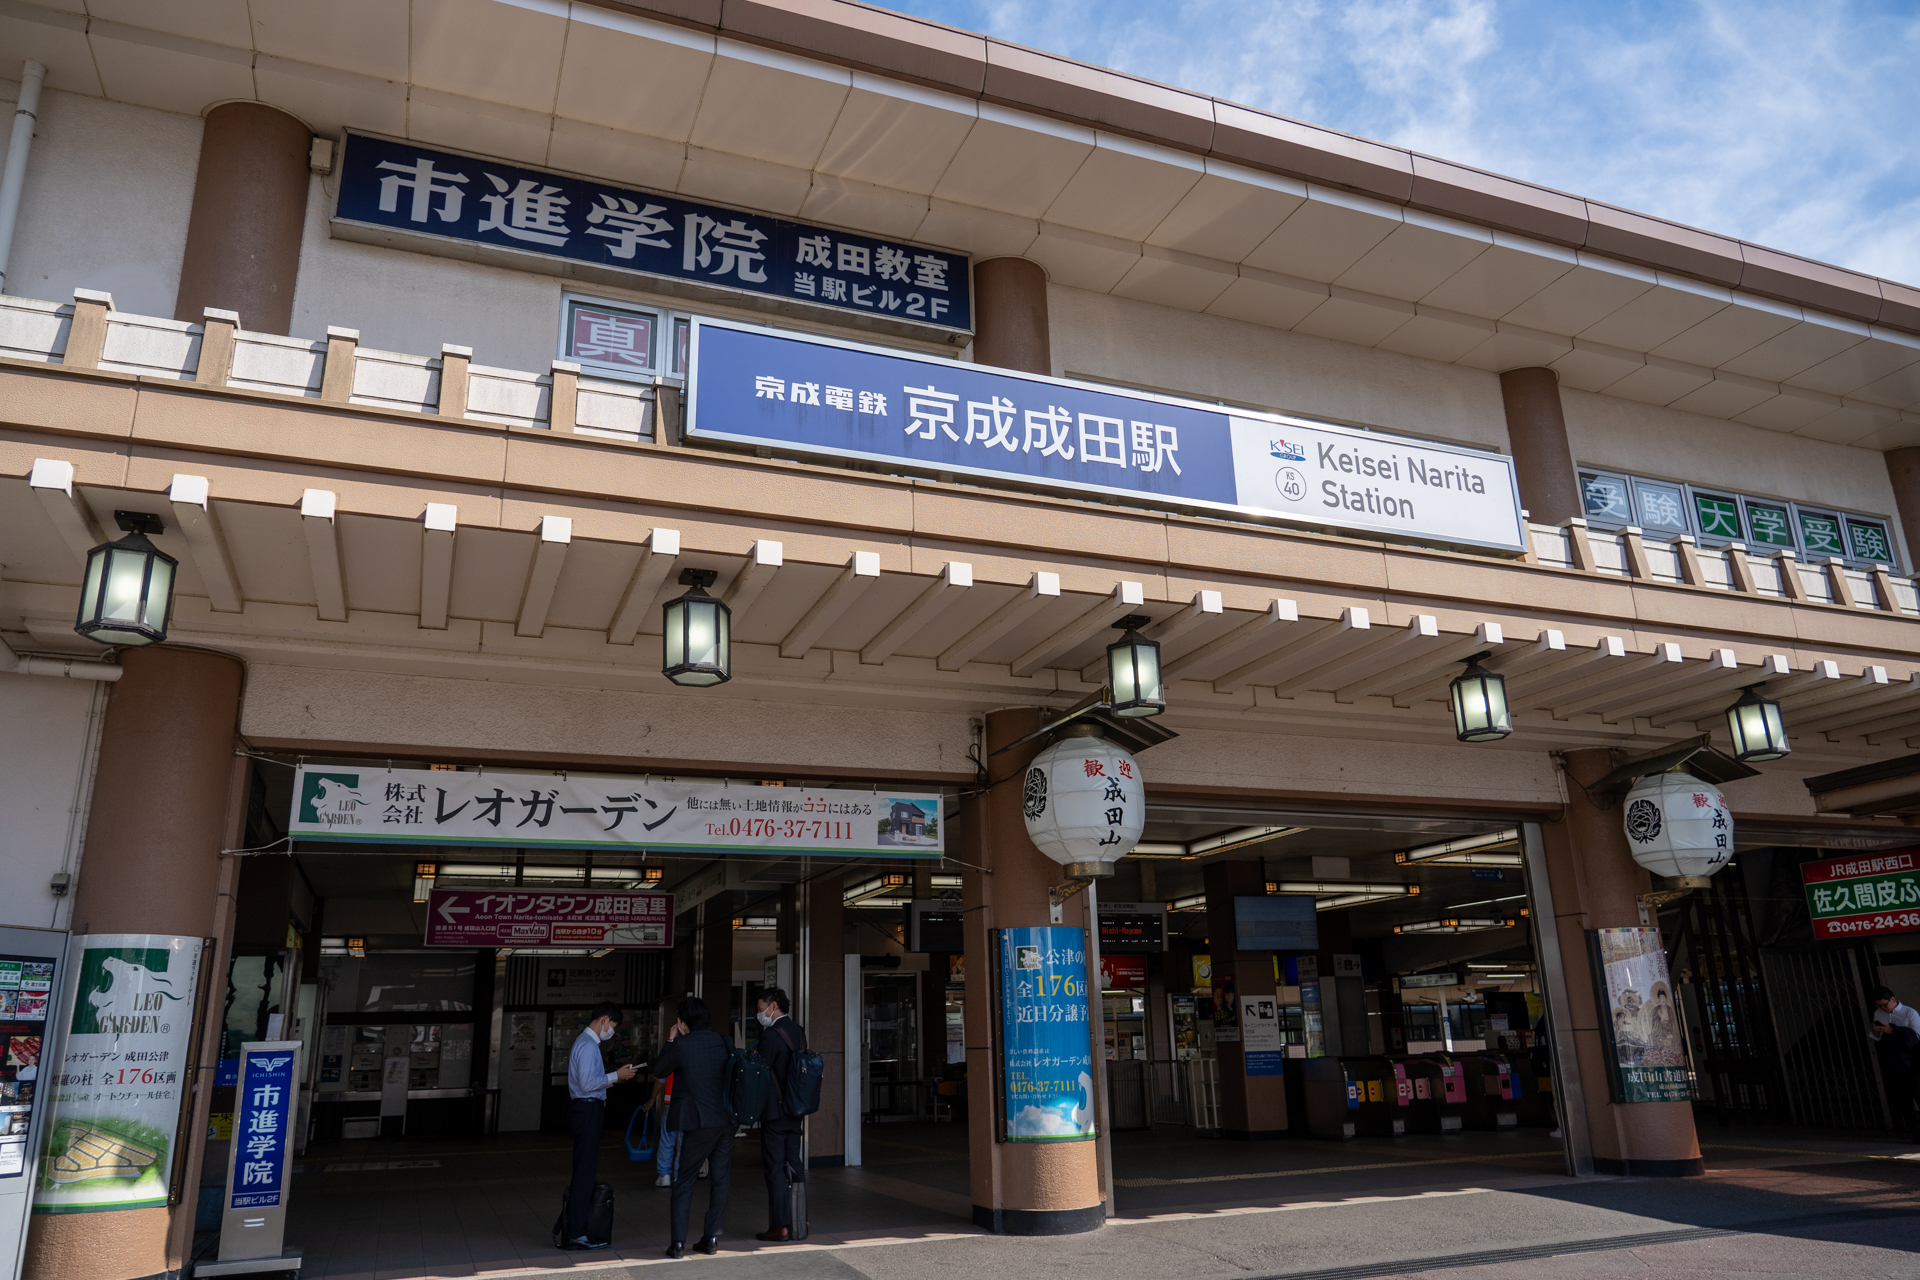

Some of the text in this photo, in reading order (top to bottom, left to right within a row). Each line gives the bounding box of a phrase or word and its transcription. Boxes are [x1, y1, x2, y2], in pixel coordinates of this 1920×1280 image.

[376, 157, 769, 284] 市進学院
[796, 235, 950, 291] 成田教室
[793, 271, 950, 320] 当駅ビル2F
[576, 316, 647, 365] 真
[755, 375, 1183, 477] 京成電鉄 京成成田駅
[1286, 471, 1295, 481] KS
[1317, 442, 1486, 495] Keisei Narita
[1283, 482, 1300, 496] 40
[1321, 480, 1415, 520] Station
[1084, 759, 1133, 780] 歓迎
[383, 782, 427, 802] 株式
[338, 800, 357, 811] LEO
[382, 804, 424, 825] 会社
[435, 787, 678, 832] レオガーデン
[686, 796, 872, 816] 他には無い土地情報がココにはある
[1099, 776, 1127, 847] 成田山
[319, 811, 356, 826] GARDEN
[1708, 808, 1728, 865] 成田山
[1830, 854, 1914, 878] JR成田駅西口
[475, 894, 668, 915] イオンタウン成田富里
[513, 914, 564, 922] Narita-tomisato
[513, 923, 545, 936] MaxValu
[133, 992, 163, 1012] LEO
[100, 1015, 161, 1034] GARDEN
[65, 1050, 169, 1063] レオガーデン 成田公津
[100, 1068, 177, 1086] 全176区画
[1010, 1080, 1076, 1093] 0476-37-7111
[243, 1084, 282, 1186] 市進学院
[234, 1194, 279, 1206] 当駅ビル2F
